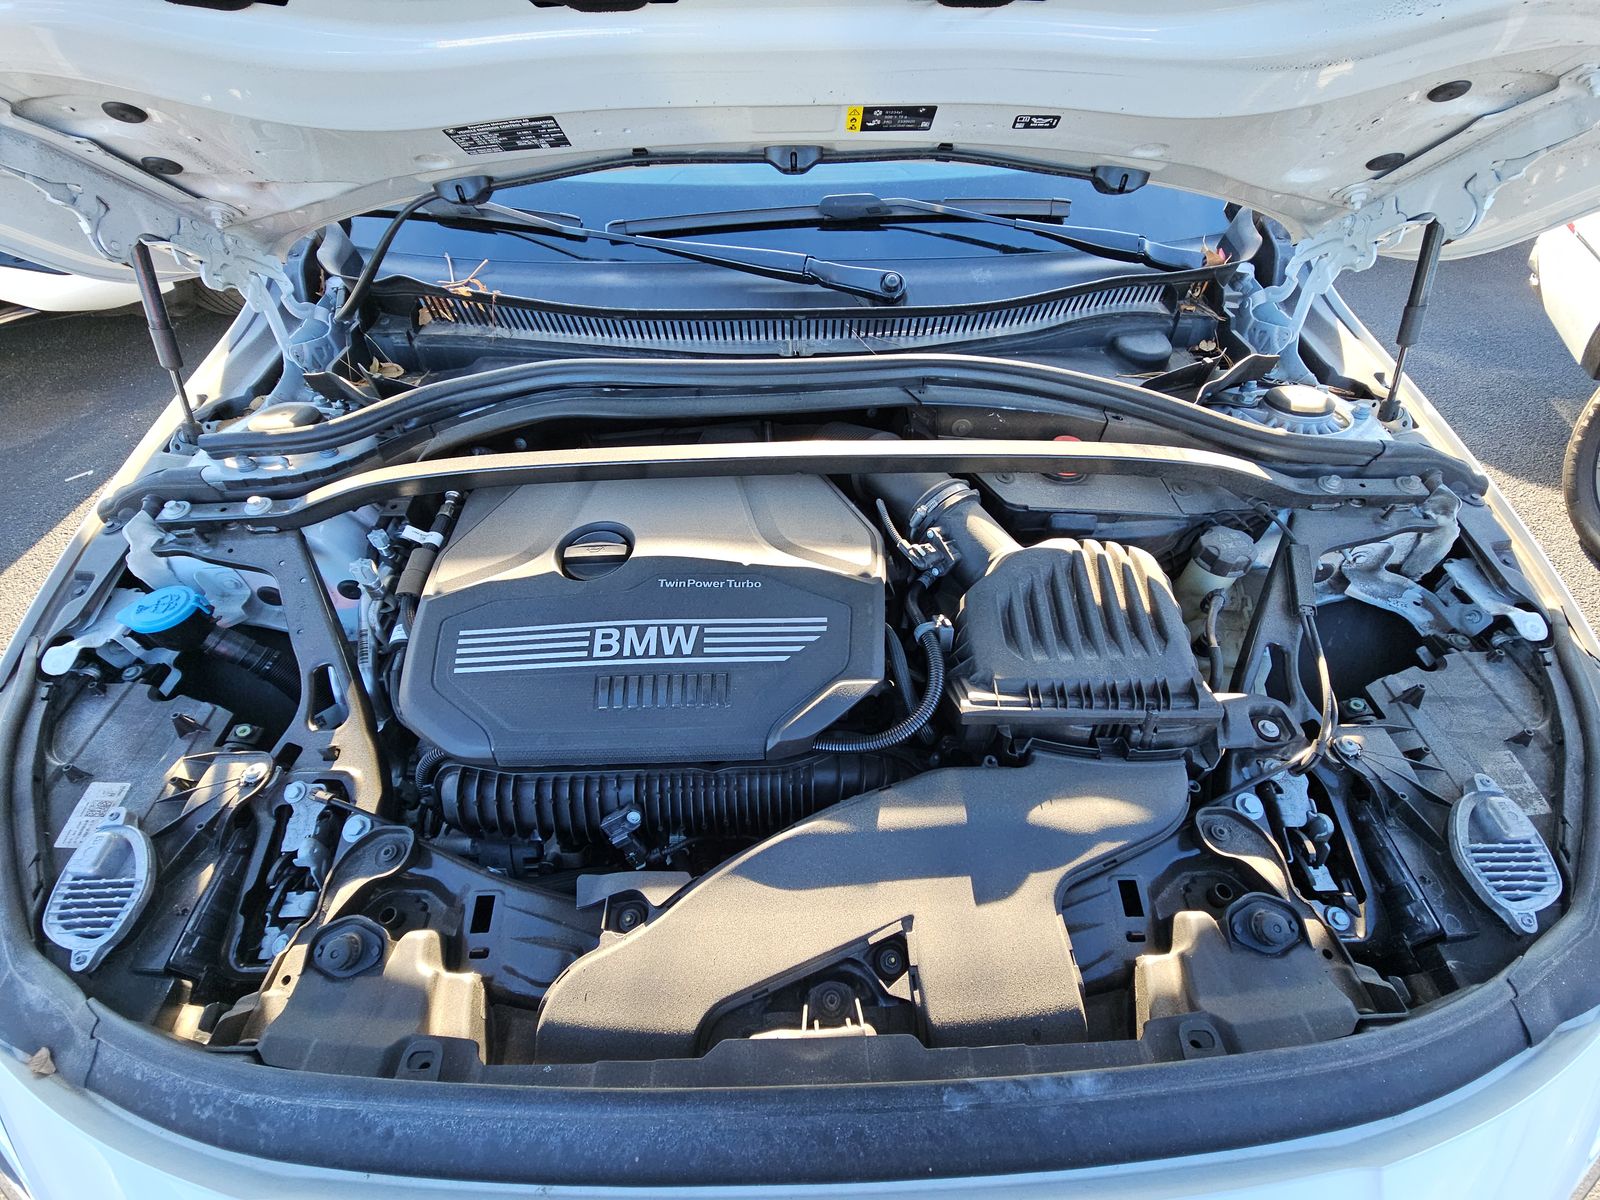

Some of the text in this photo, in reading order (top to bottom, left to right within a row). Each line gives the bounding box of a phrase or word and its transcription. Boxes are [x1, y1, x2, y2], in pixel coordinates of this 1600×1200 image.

[658, 578, 763, 589] TwinPower Turbo
[592, 625, 700, 658] BMW
